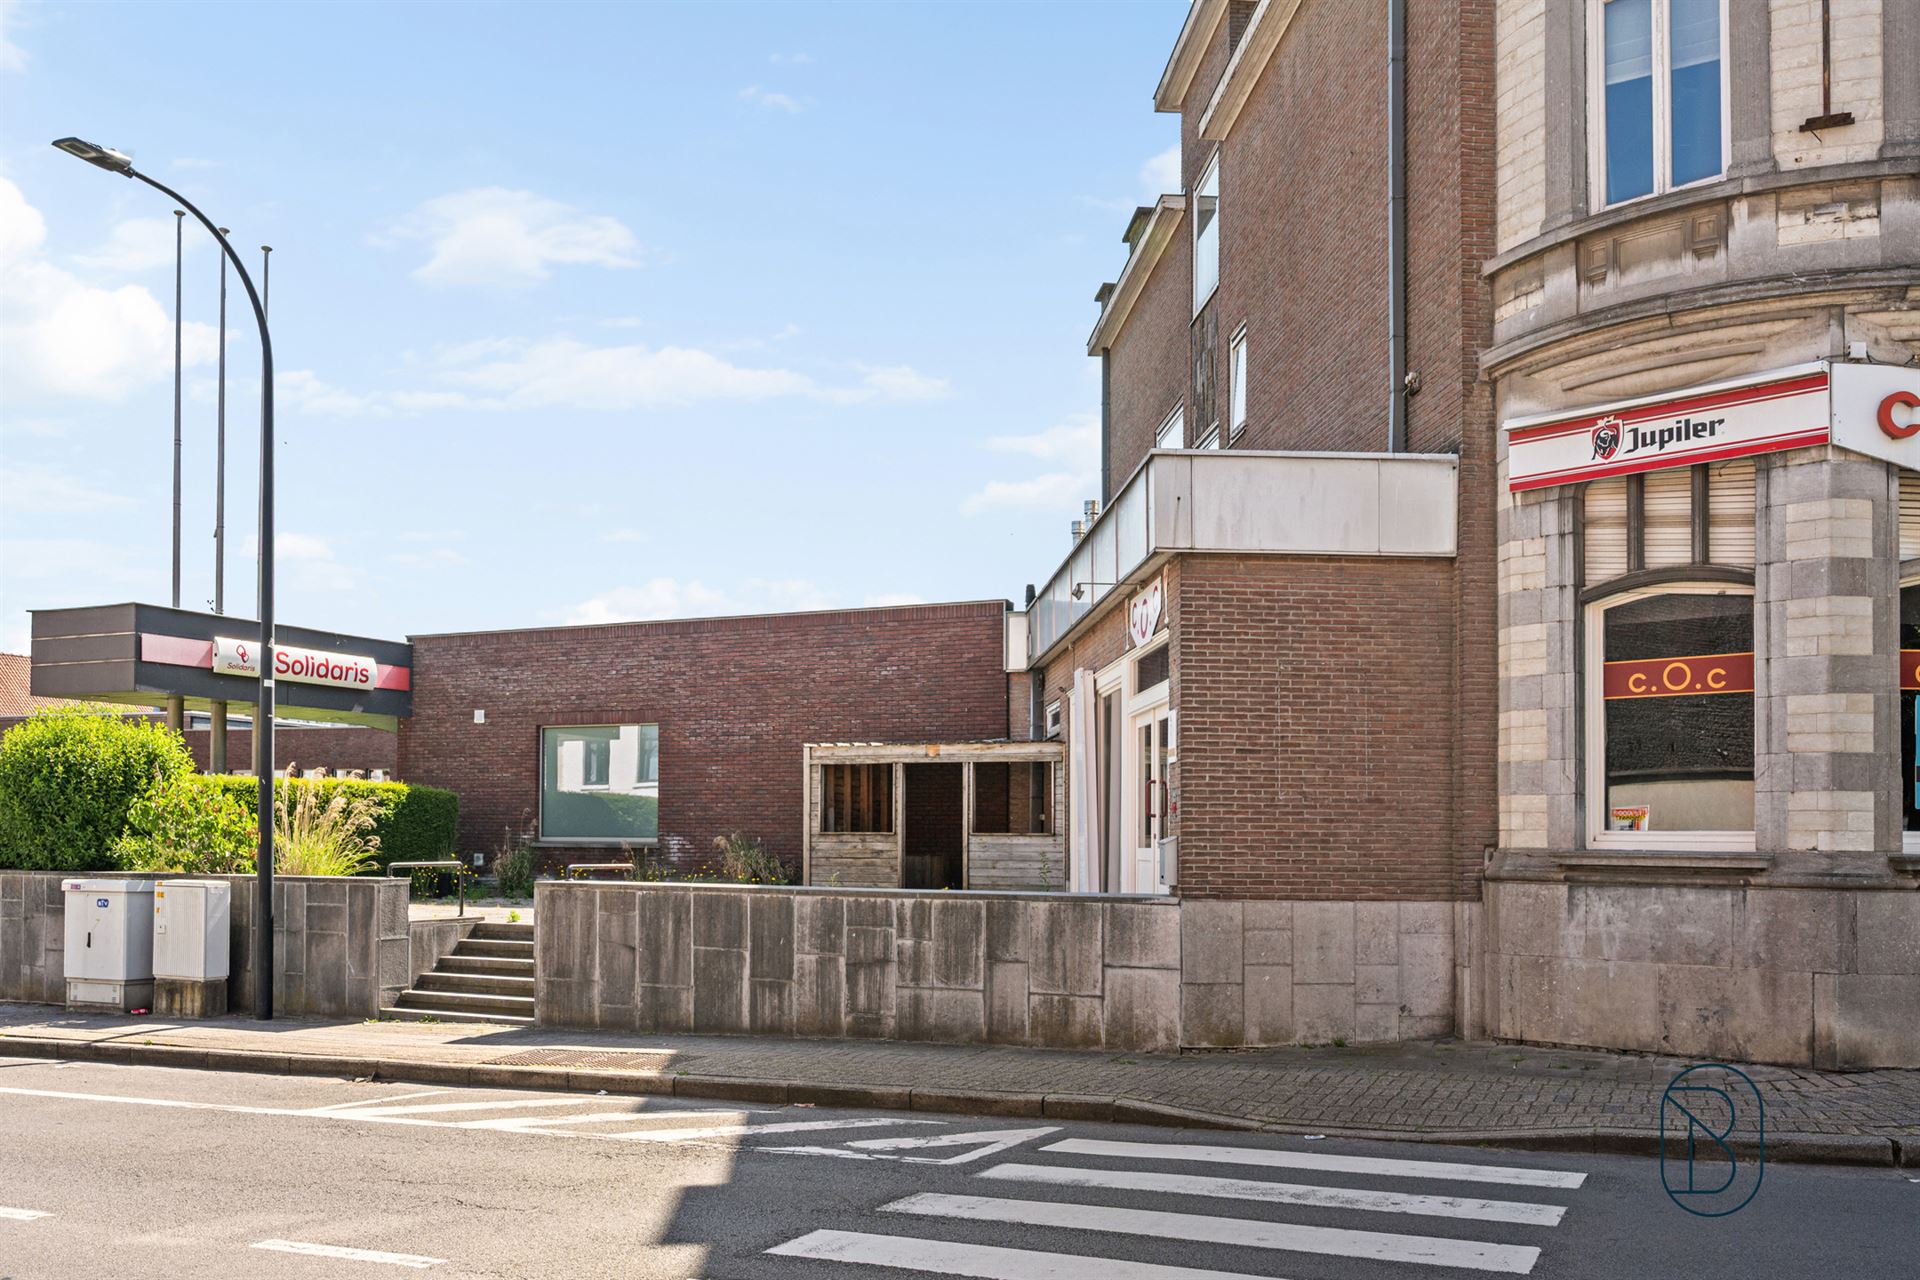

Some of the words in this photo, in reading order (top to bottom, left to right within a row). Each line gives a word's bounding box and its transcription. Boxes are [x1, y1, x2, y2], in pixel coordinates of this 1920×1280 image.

[1624, 418, 1725, 454] Jupiler
[227, 662, 256, 673] Solidaris
[275, 651, 370, 684] Solidaris
